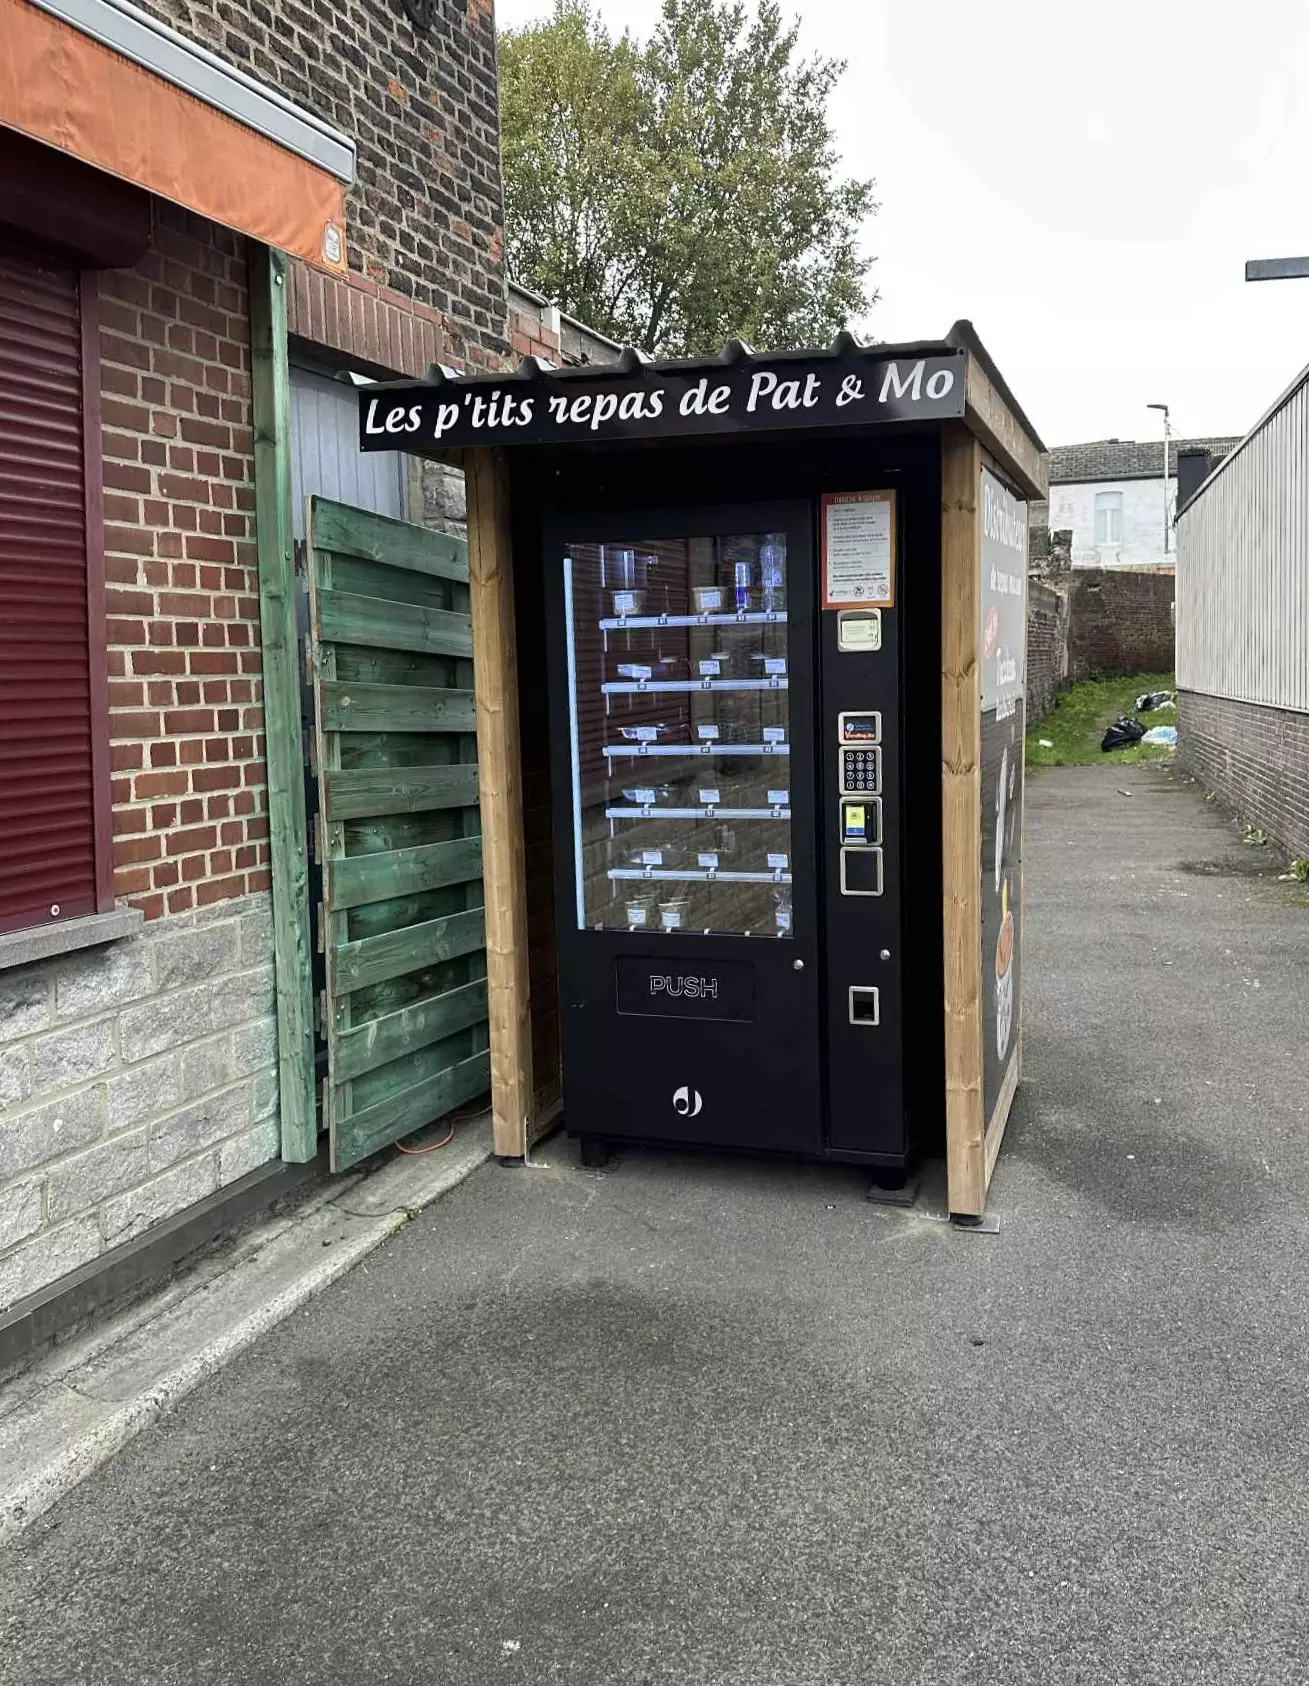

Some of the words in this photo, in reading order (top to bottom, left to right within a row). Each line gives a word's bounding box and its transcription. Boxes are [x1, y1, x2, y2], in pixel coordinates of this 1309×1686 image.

[365, 399, 422, 434] Les
[433, 391, 535, 440] p'tits
[548, 389, 665, 431] repas
[679, 378, 731, 416] de
[746, 372, 821, 412] Pat
[835, 374, 865, 407] &
[878, 360, 955, 403] Mo
[650, 975, 719, 999] PUSH
